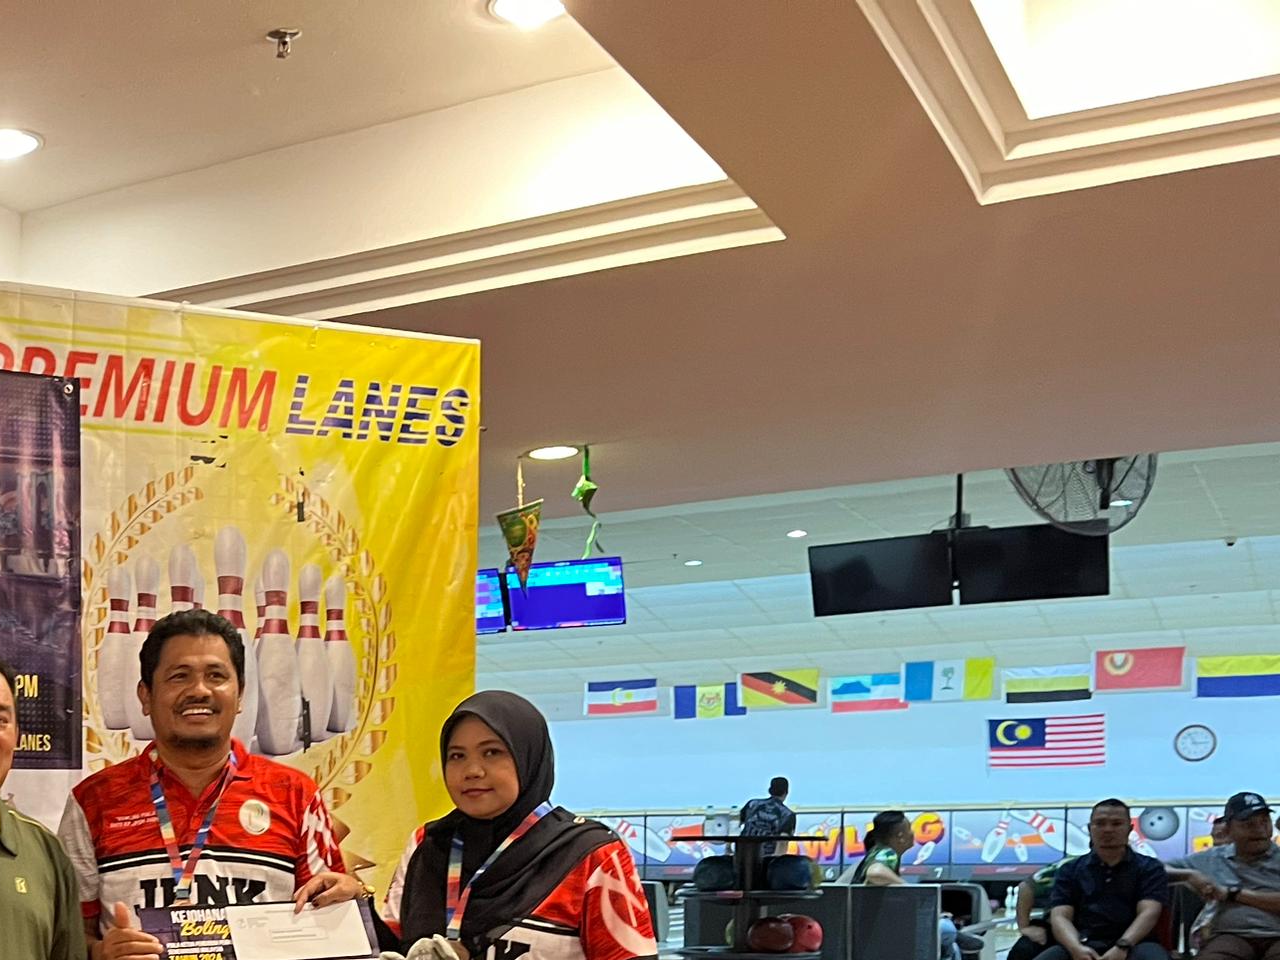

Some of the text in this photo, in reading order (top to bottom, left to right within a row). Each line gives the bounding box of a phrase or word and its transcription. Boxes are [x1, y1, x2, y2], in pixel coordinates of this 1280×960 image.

[286, 375, 470, 447] LANES
[825, 868, 834, 879] 6
[934, 867, 943, 879] 7
[180, 920, 230, 940] Boling
